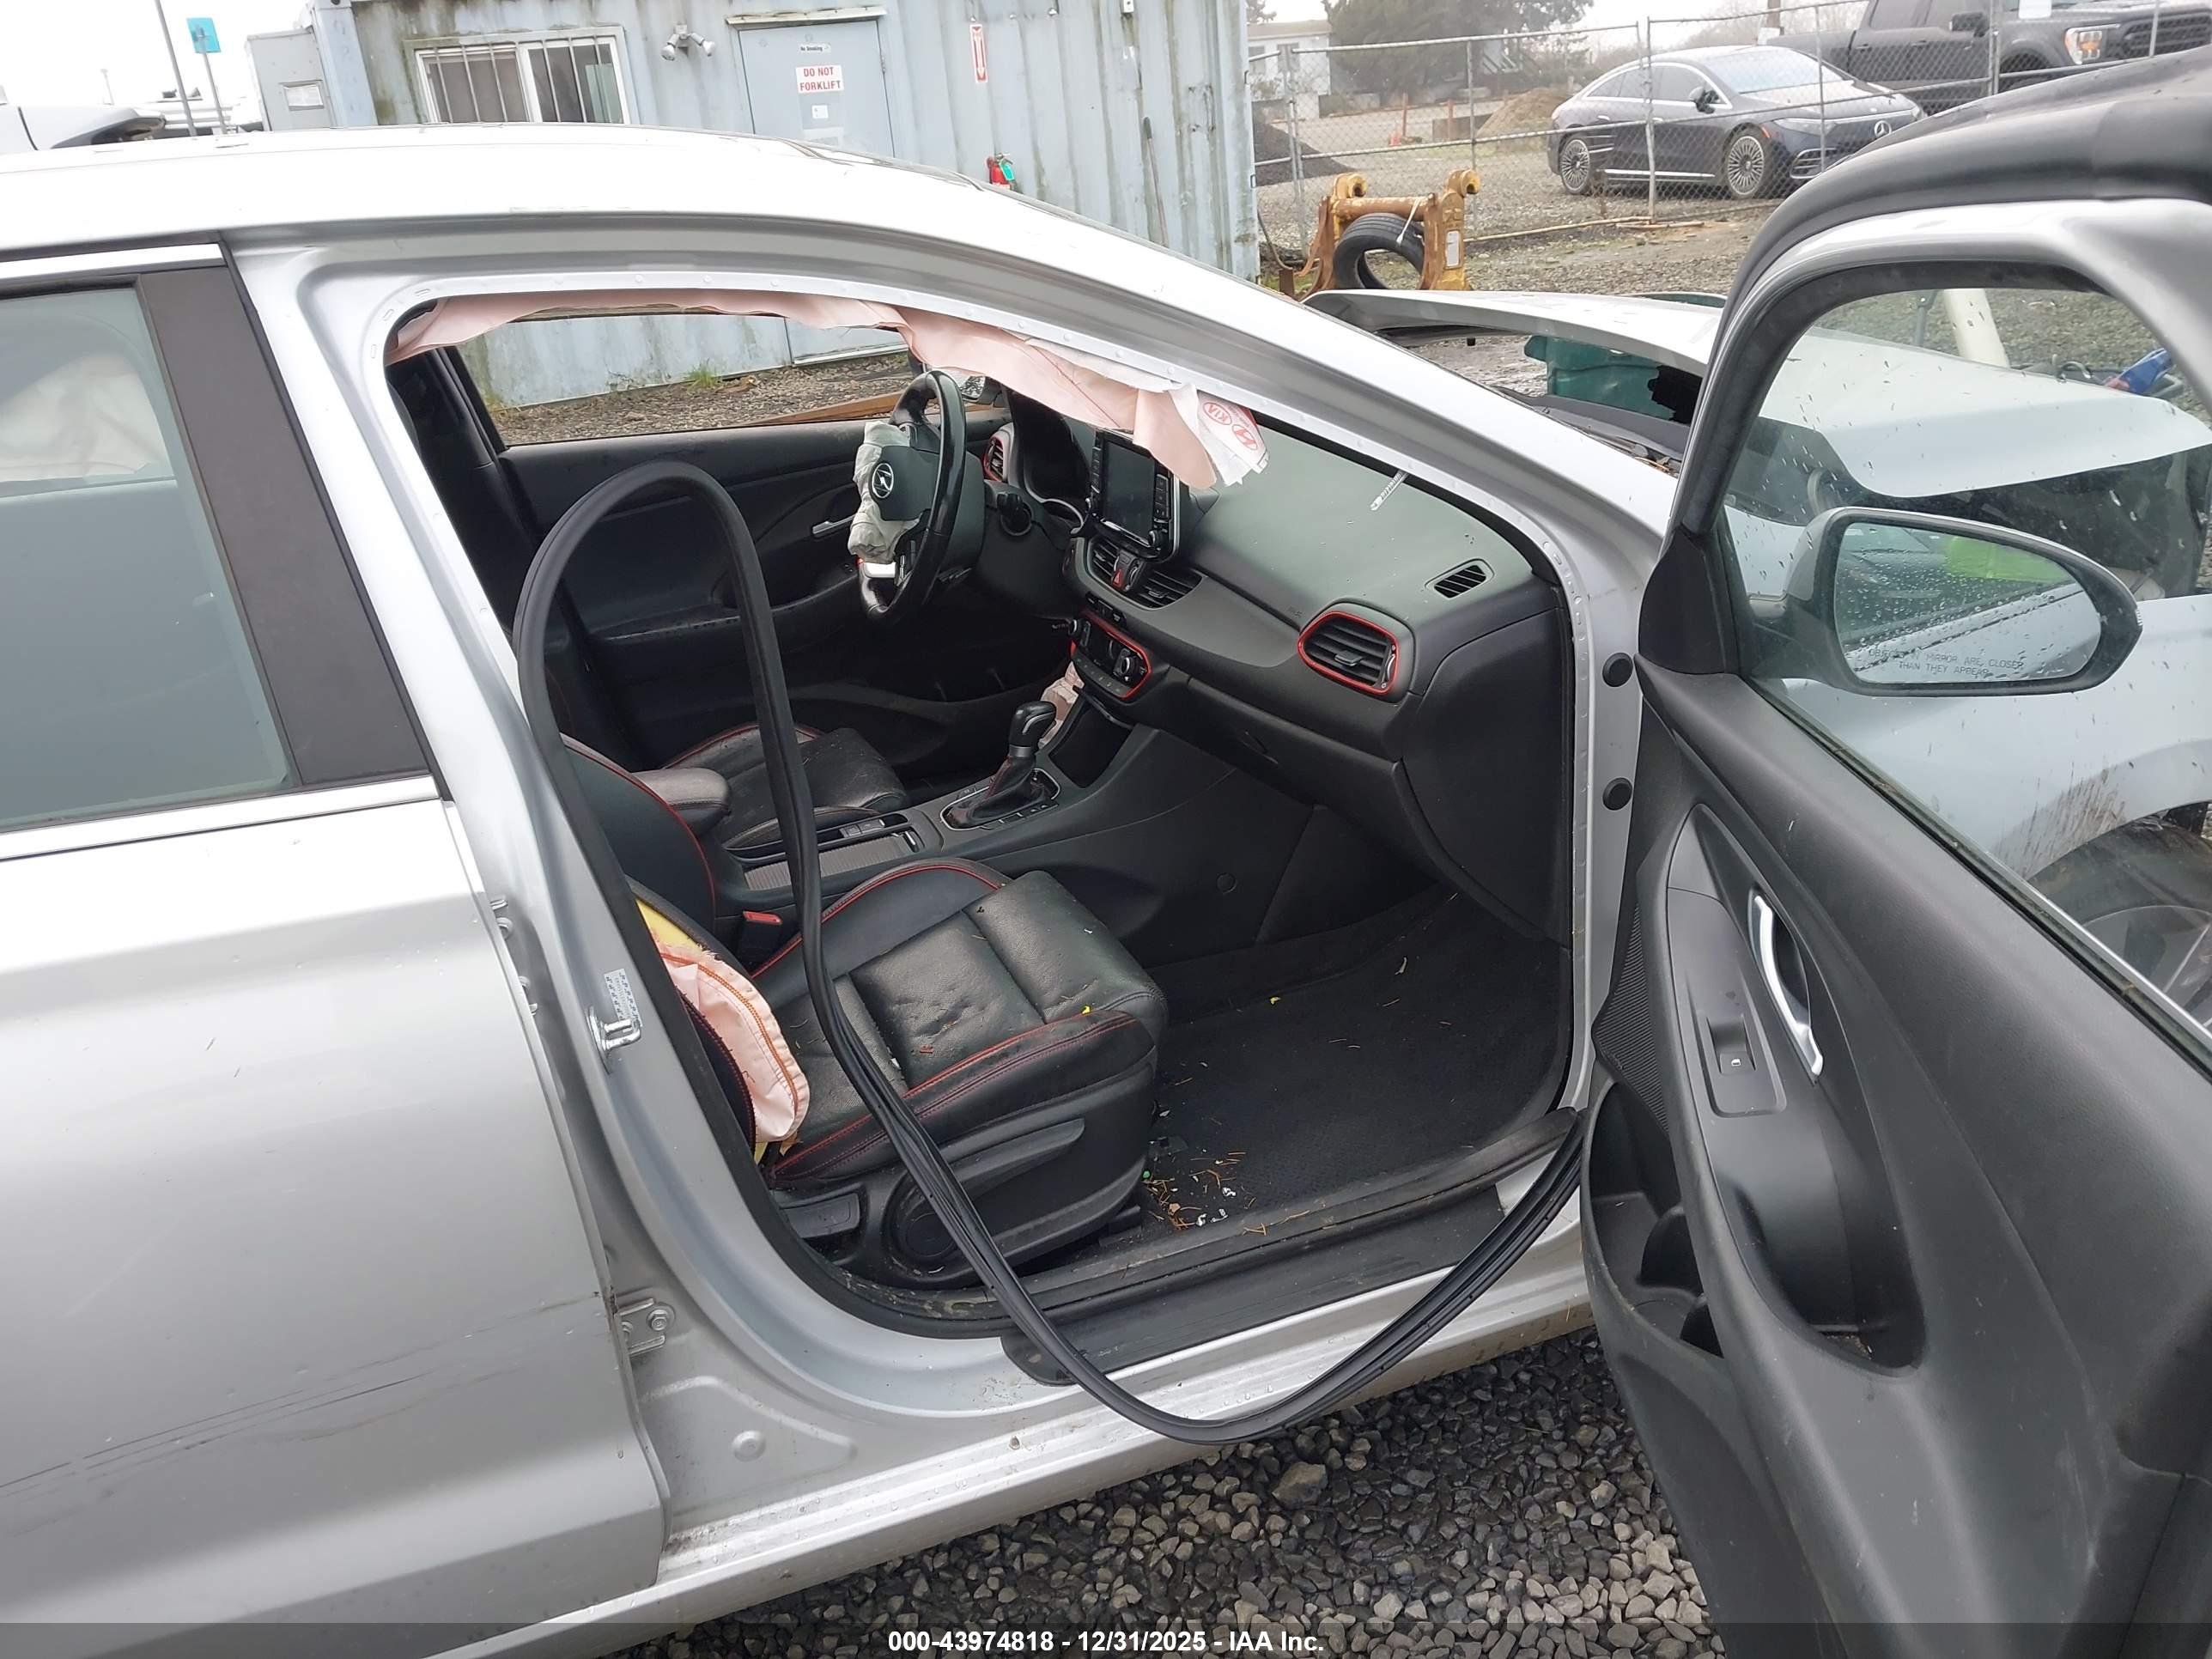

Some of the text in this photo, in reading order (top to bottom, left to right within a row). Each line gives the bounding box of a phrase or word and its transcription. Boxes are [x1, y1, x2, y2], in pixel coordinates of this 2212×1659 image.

[803, 66, 834, 77] DO NOT
[799, 80, 841, 91] FORKLIFT
[1206, 404, 1230, 423] KIA
[1899, 661, 1920, 670] THAN
[1926, 664, 1948, 673] THEY
[1964, 657, 1983, 666] ARE
